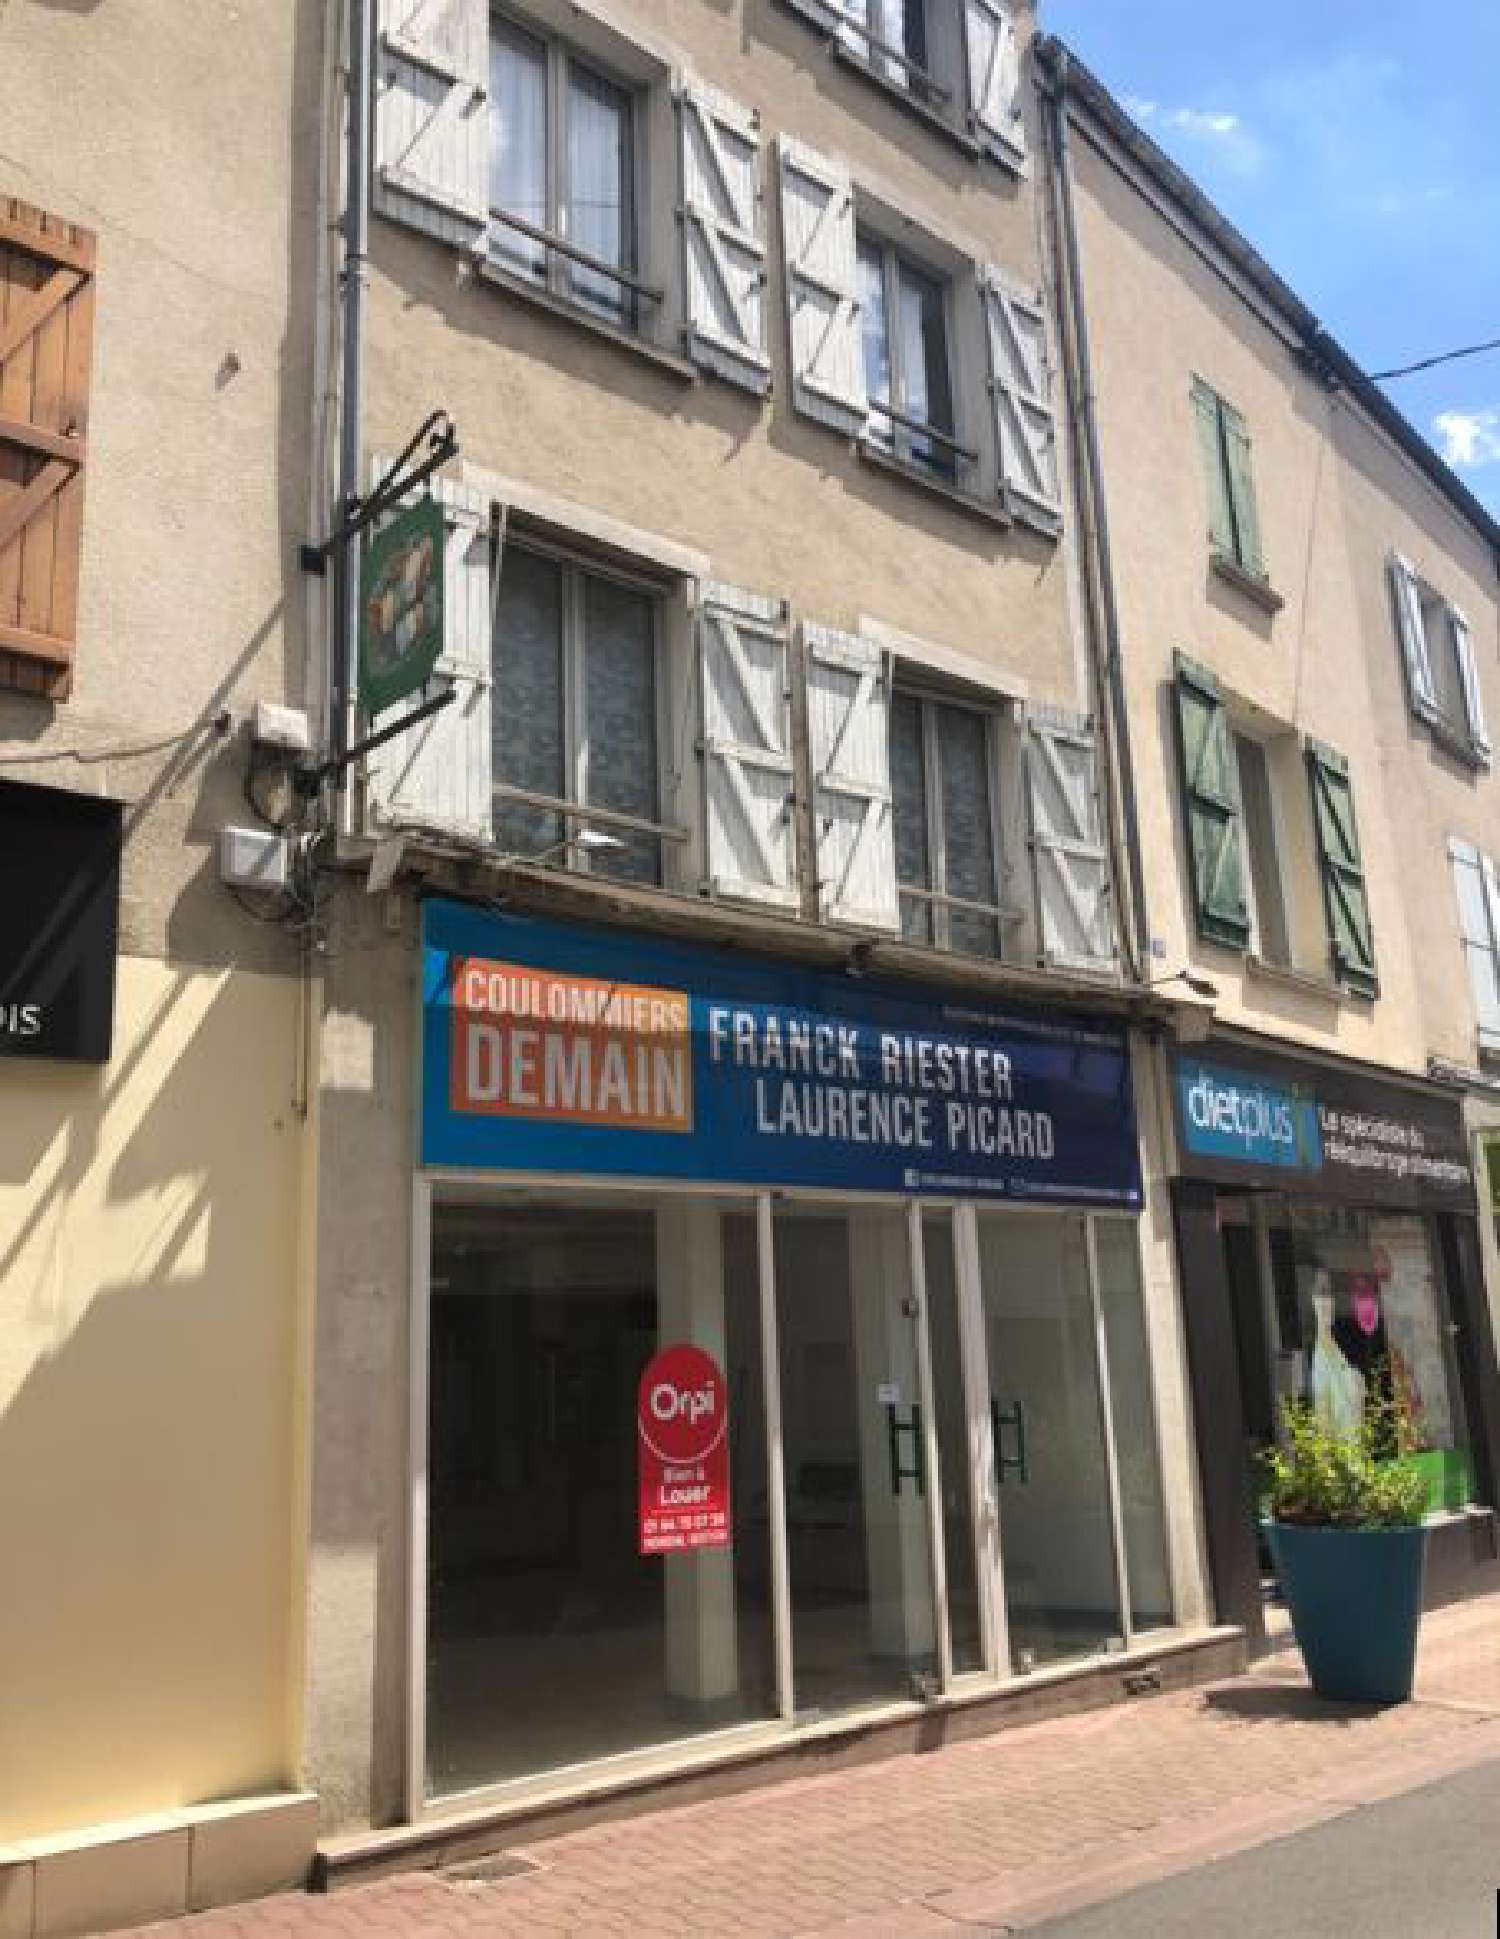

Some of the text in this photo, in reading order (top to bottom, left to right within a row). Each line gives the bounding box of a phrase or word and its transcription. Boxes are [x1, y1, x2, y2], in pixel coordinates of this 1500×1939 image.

[465, 969, 682, 1032] COULOMMIERS
[466, 1022, 685, 1117] DEMAIN
[709, 1006, 861, 1079] FRANCK
[881, 1033, 1013, 1099] RIESTER
[756, 1079, 1055, 1161] LAURENCE PICARD
[1187, 1071, 1293, 1150] dietplus
[650, 1381, 715, 1424] Orpi
